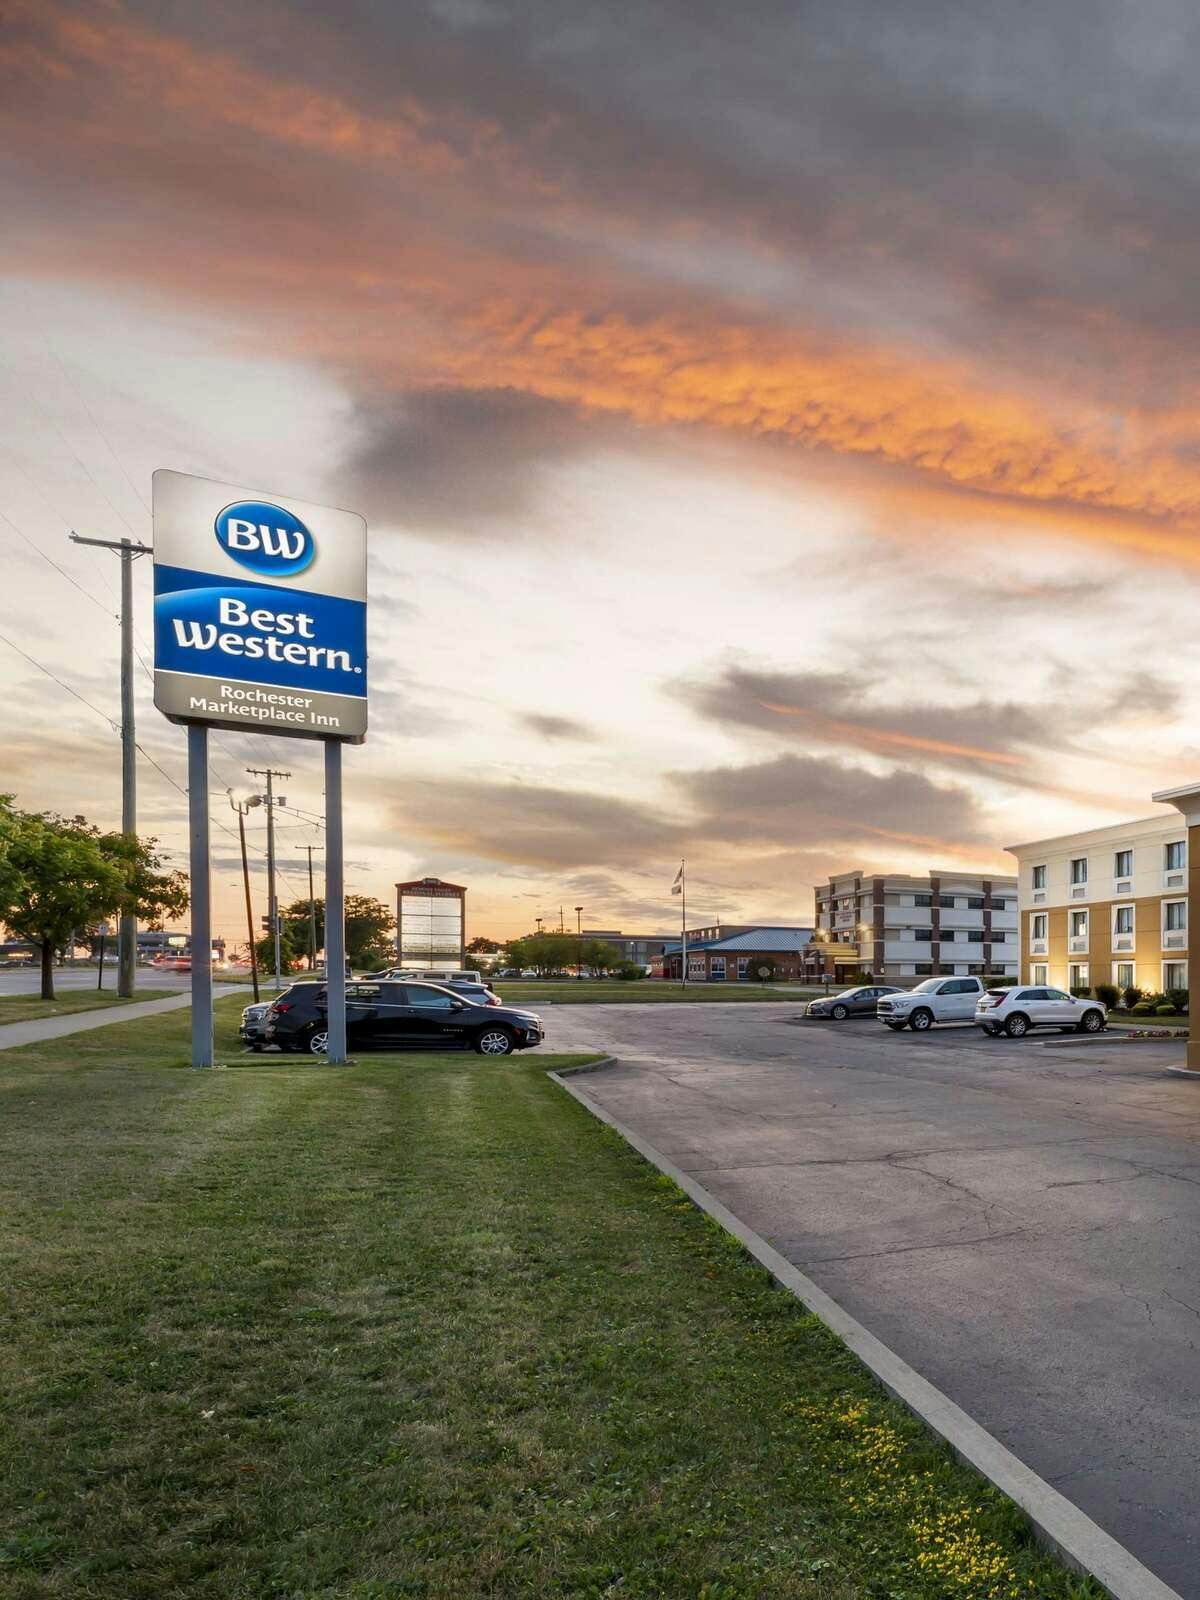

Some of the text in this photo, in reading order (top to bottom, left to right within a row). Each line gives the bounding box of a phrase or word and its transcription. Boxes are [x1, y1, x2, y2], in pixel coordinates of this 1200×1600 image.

[227, 518, 304, 559] BW
[219, 597, 315, 638] Best
[189, 697, 340, 727] Marketplace Inn
[220, 685, 312, 709] Rochester
